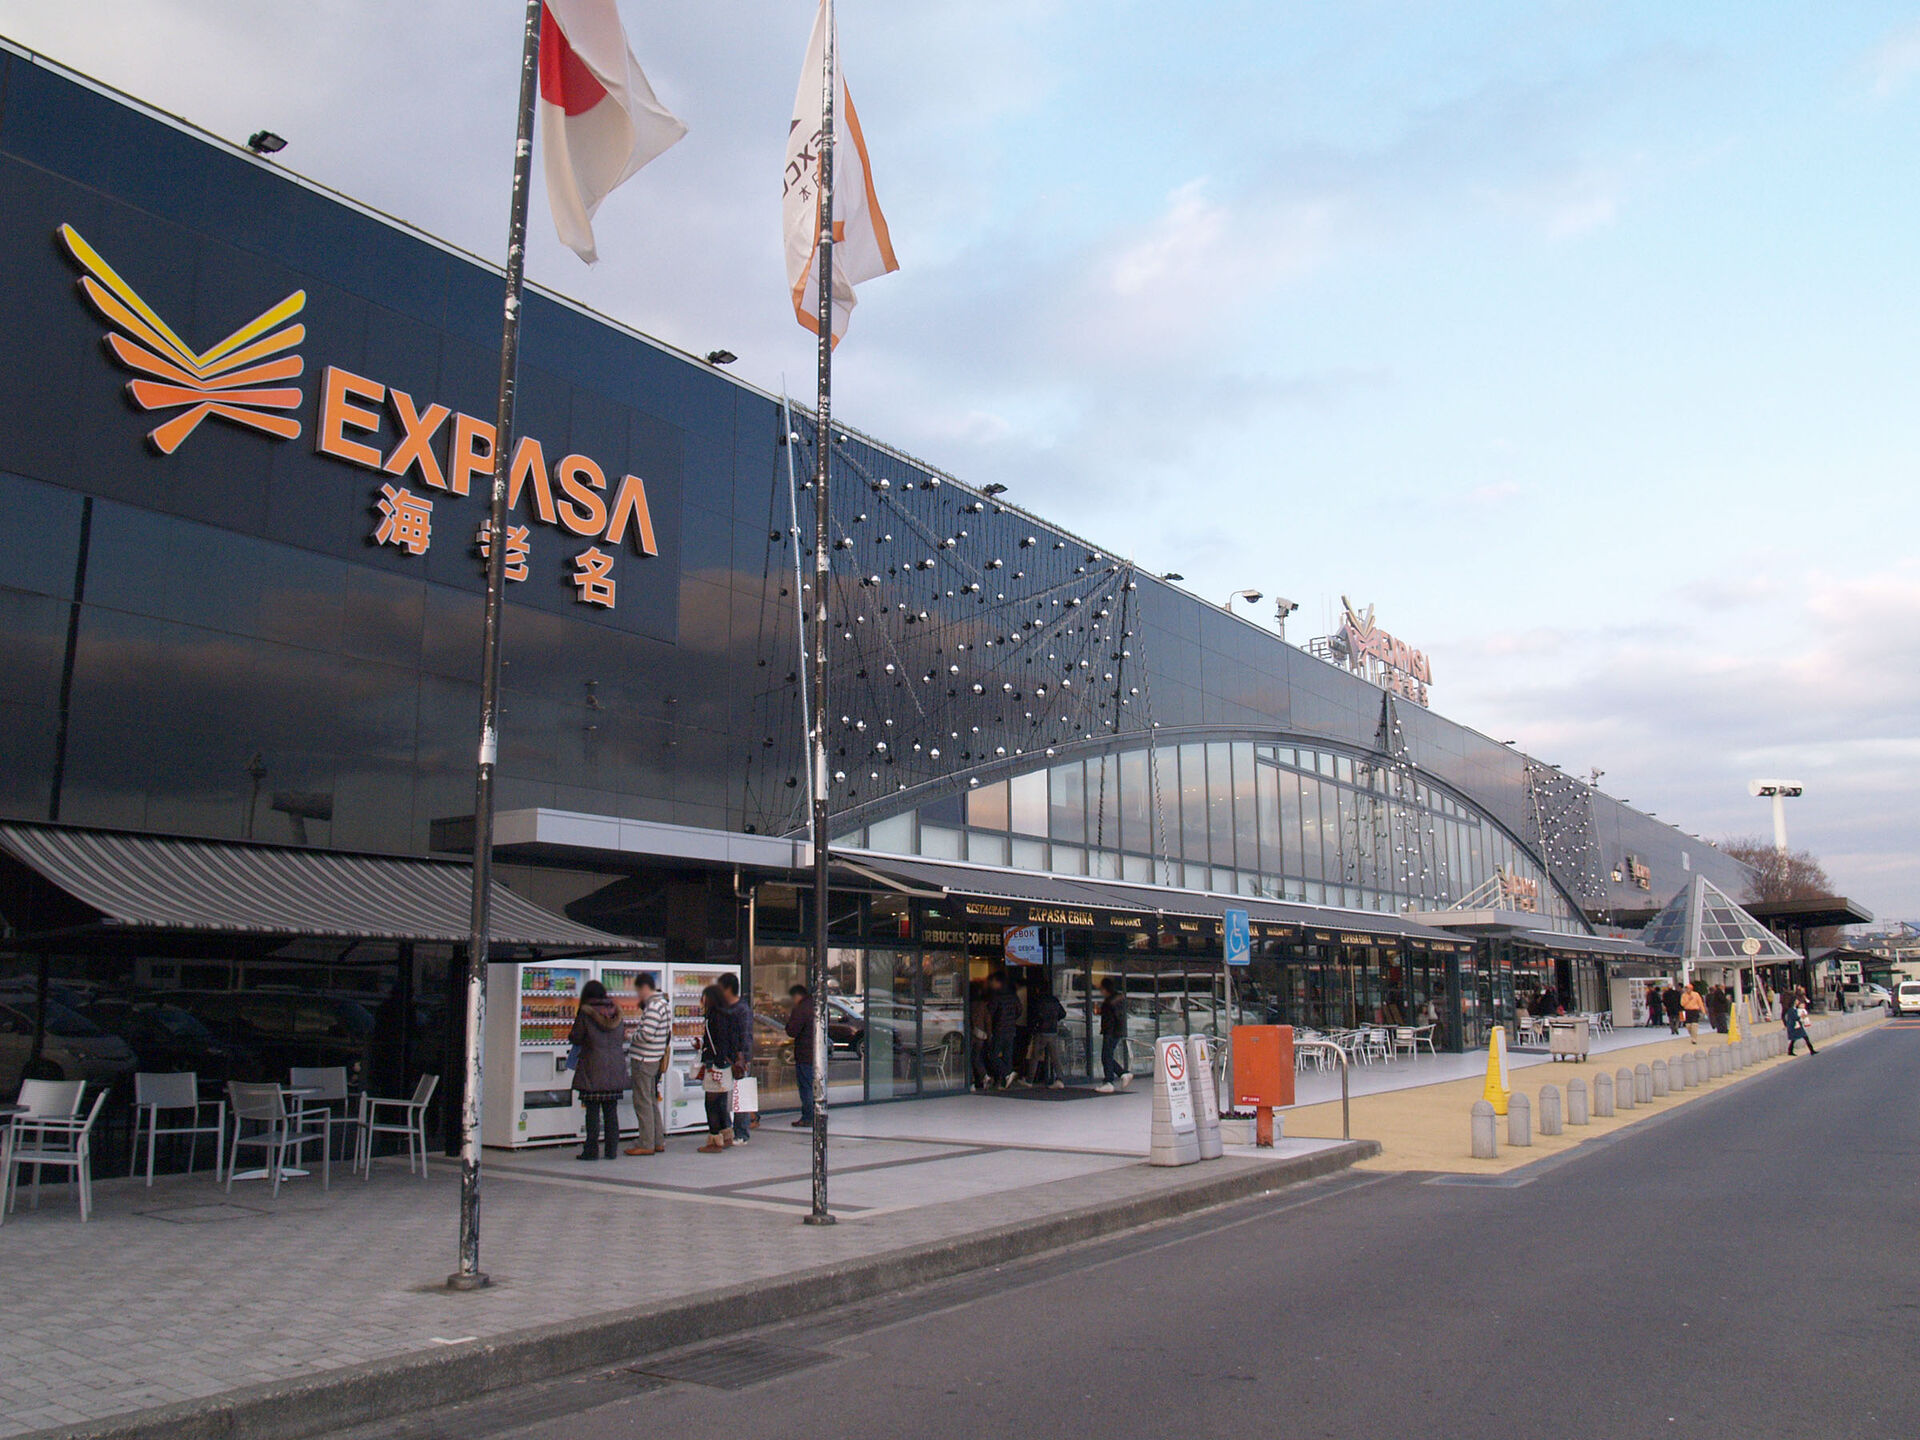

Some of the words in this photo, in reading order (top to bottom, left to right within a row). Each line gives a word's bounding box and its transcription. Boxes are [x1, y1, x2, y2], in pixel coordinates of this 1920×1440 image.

[315, 365, 659, 558] EXPASA
[372, 482, 617, 609] 海老名
[1028, 907, 1068, 924] EXPASA
[1068, 910, 1095, 926] EBINA
